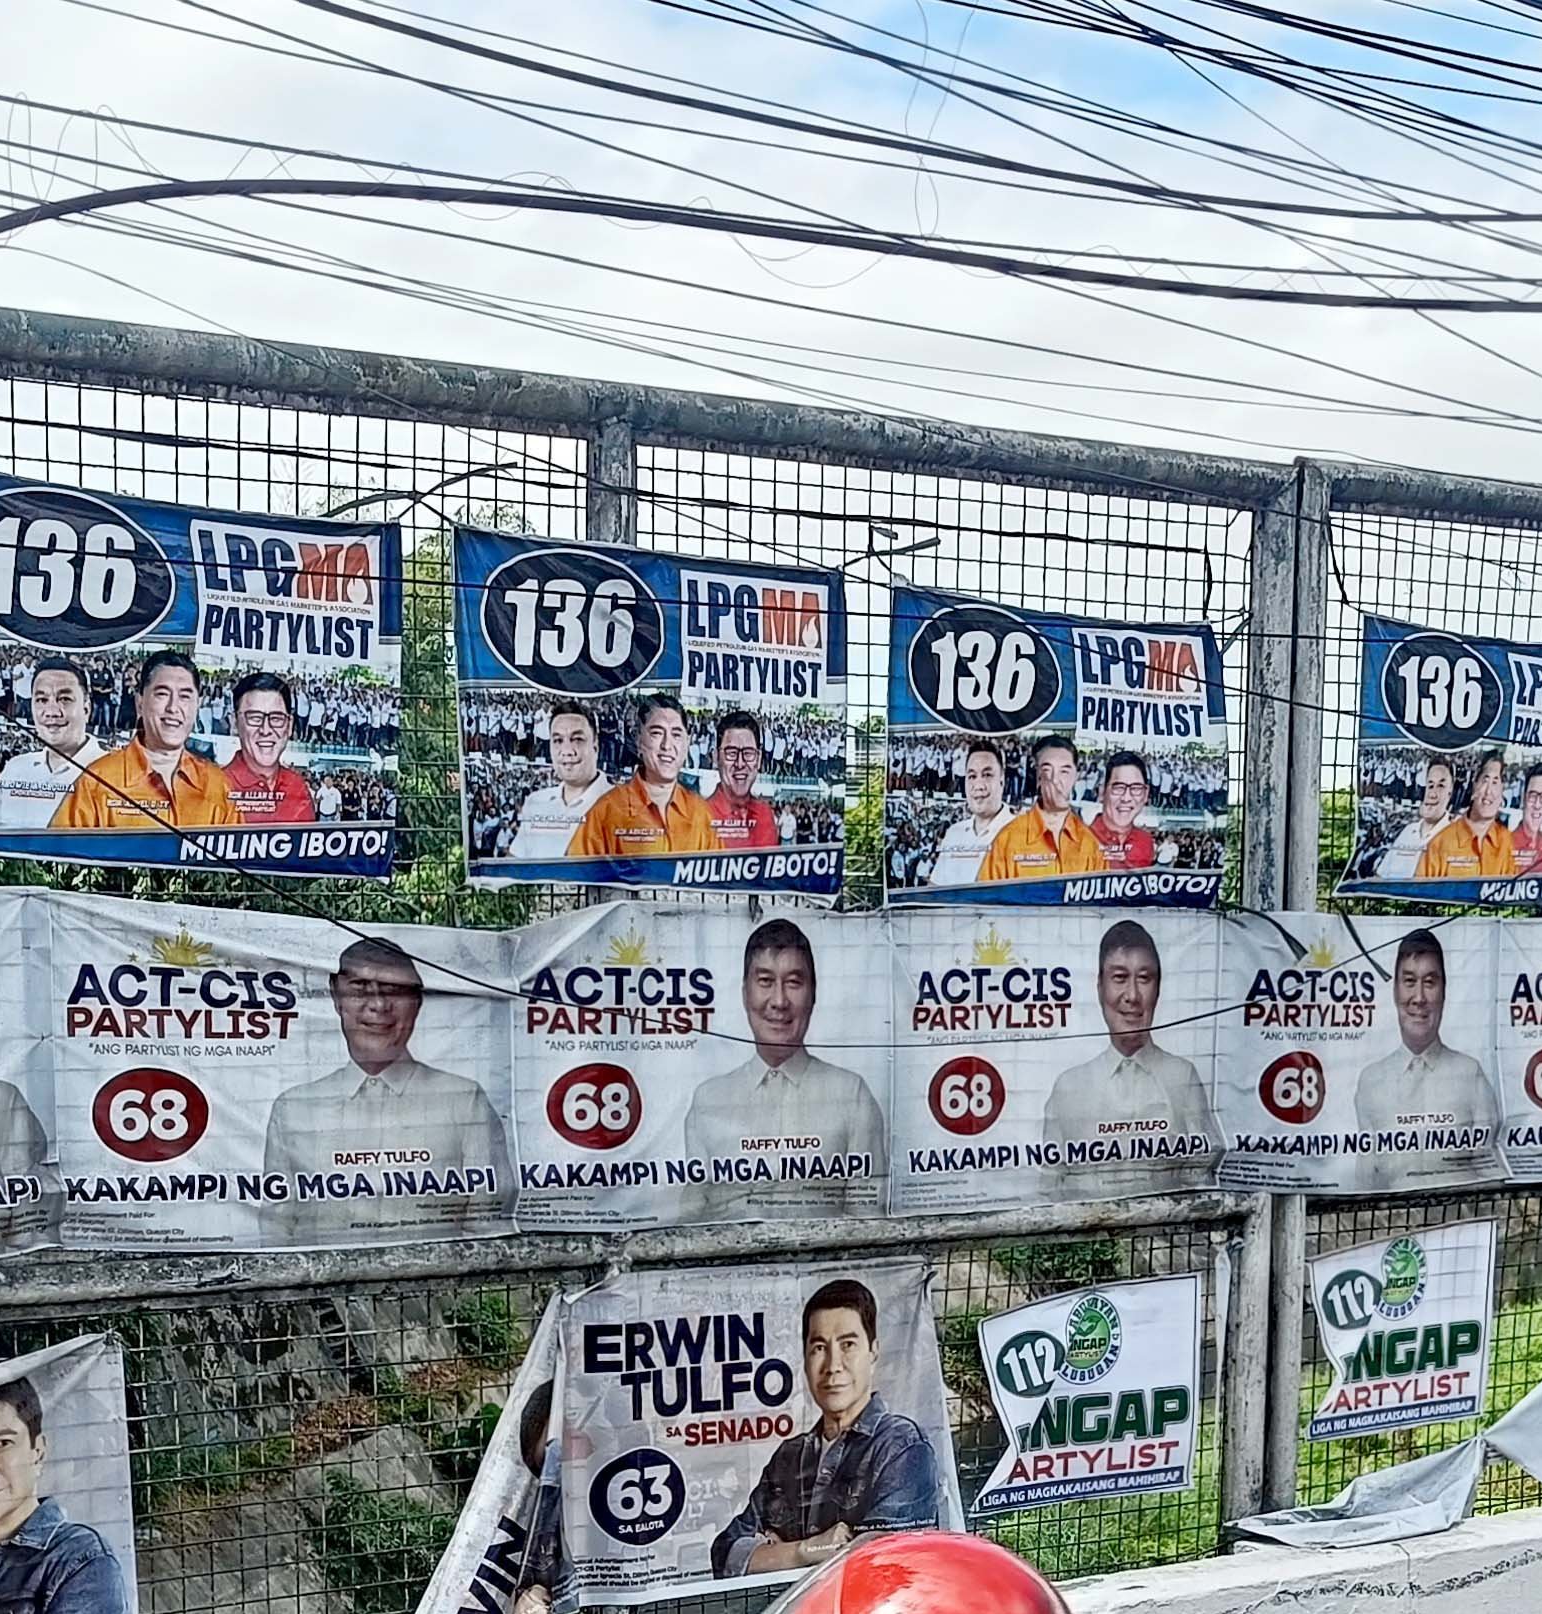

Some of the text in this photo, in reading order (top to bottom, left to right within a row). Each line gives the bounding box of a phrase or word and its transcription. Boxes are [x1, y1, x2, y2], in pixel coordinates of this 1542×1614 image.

[196, 528, 373, 606] LPGMA
[203, 604, 372, 660] PARTYLIST
[504, 578, 820, 668] 136 LPGMA
[687, 654, 820, 699] PARTYLIST
[933, 630, 1202, 712] 136 LPGMA
[1081, 694, 1204, 737] PARTYLIST
[180, 830, 388, 862] MULING IBOTO!
[673, 851, 836, 883] MULING IBOTO!
[1063, 877, 1142, 902] MULING
[67, 963, 297, 1010] ACT-CIS
[530, 966, 715, 1006] ACT-CIS
[916, 967, 1072, 1005] ACT-CIS
[1250, 969, 1375, 1002] ACT-CIS
[67, 1006, 299, 1040] PARTYLIST
[913, 1003, 1071, 1031] PARTYLIST
[909, 1133, 1210, 1174] KAKAMPI NG MGA INAAPI
[584, 1313, 763, 1374] ERWIN
[1003, 1337, 1055, 1392] 112
[621, 1359, 793, 1420] TULFO
[685, 1415, 793, 1446] SENADO
[1016, 1386, 1190, 1452] NGAP
[1007, 1441, 1179, 1484] ARTYLIST
[618, 1468, 672, 1513] 63
[983, 1493, 1007, 1506] LIGA
[1010, 1491, 1025, 1501] NG
[1028, 1478, 1115, 1500] NAGKAKAISANG
